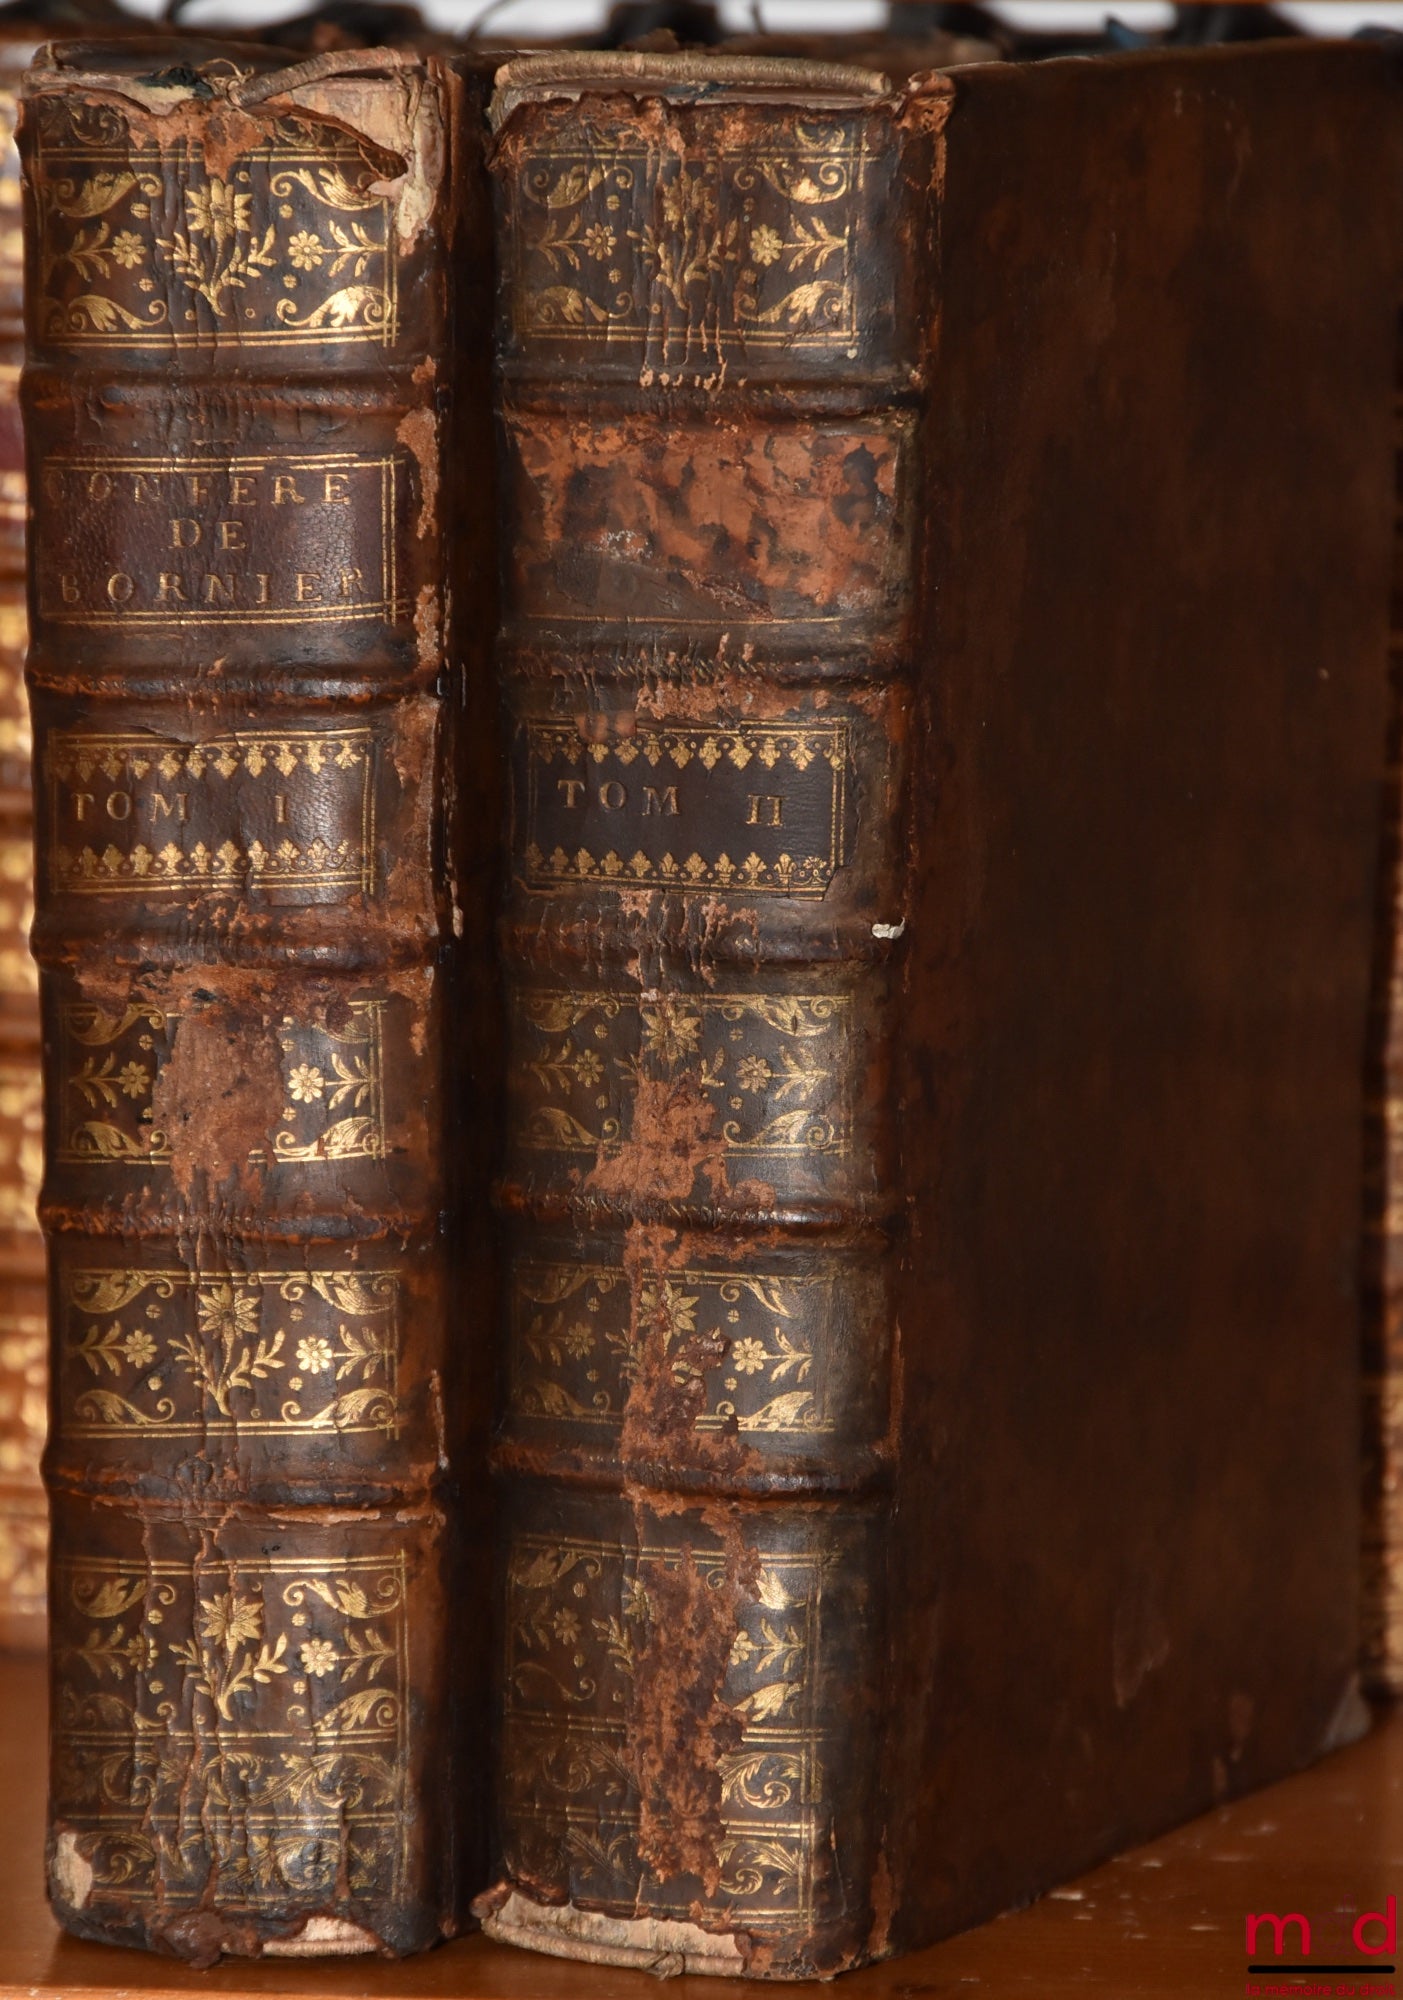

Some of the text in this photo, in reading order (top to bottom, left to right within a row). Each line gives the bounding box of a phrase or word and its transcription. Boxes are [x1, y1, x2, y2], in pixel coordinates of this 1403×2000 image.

[168, 517, 248, 551] DE
[60, 567, 369, 604] BORNIER
[72, 790, 291, 825] TOM I
[557, 779, 787, 827] TOM II
